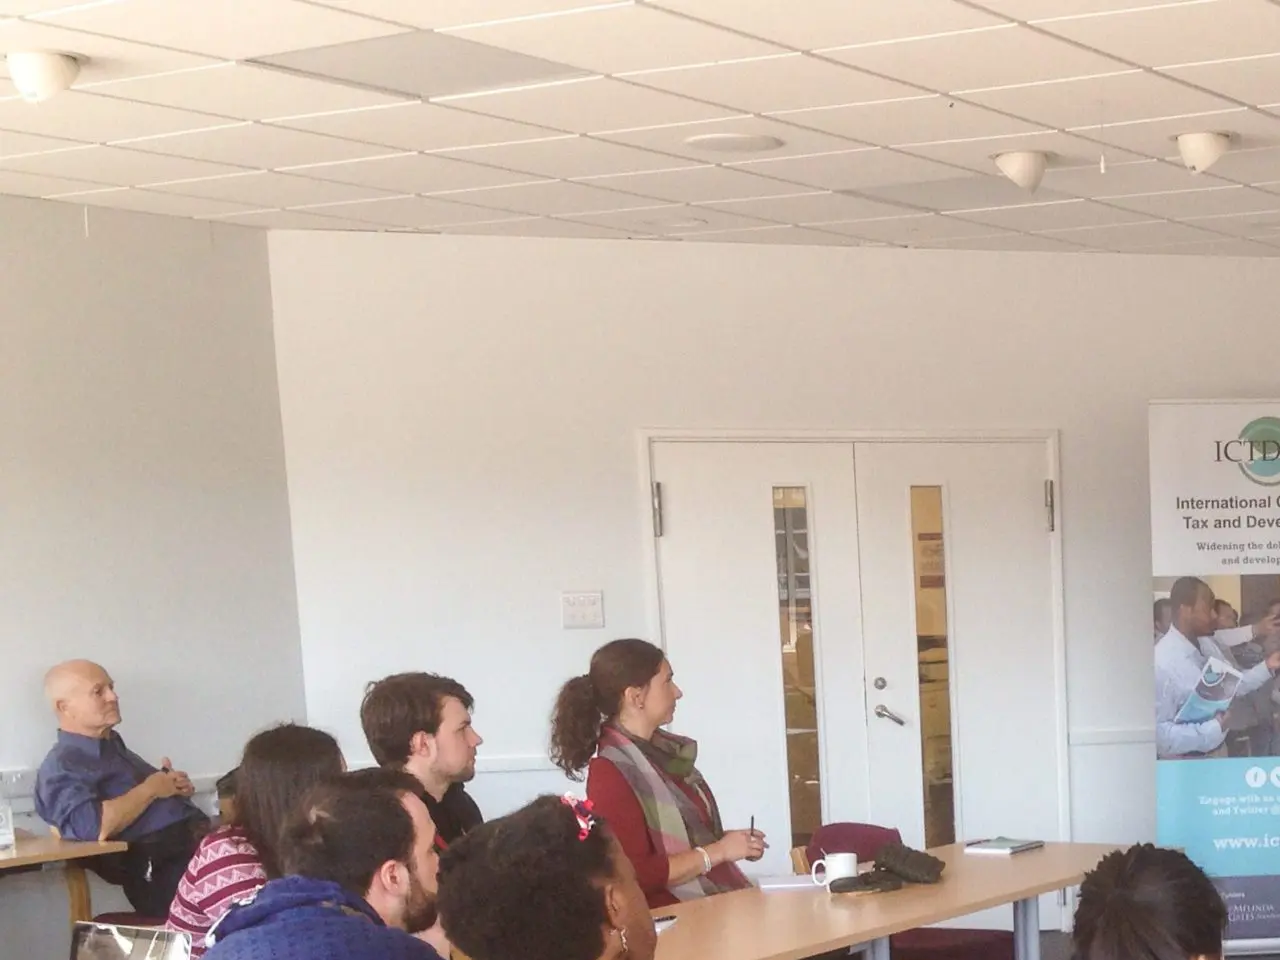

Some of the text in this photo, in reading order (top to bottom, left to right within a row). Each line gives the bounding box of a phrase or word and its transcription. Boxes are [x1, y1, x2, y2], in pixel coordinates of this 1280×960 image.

[1176, 495, 1272, 510] International
[1183, 516, 1209, 530] Tax
[1213, 515, 1242, 530] and
[1196, 541, 1245, 553] Widening
[1247, 541, 1264, 551] the
[1221, 556, 1240, 566] and
[1200, 796, 1236, 807] Engage
[1239, 794, 1260, 804] with
[1263, 795, 1275, 803] us
[1214, 807, 1231, 816] and
[1233, 806, 1268, 815] Twitter
